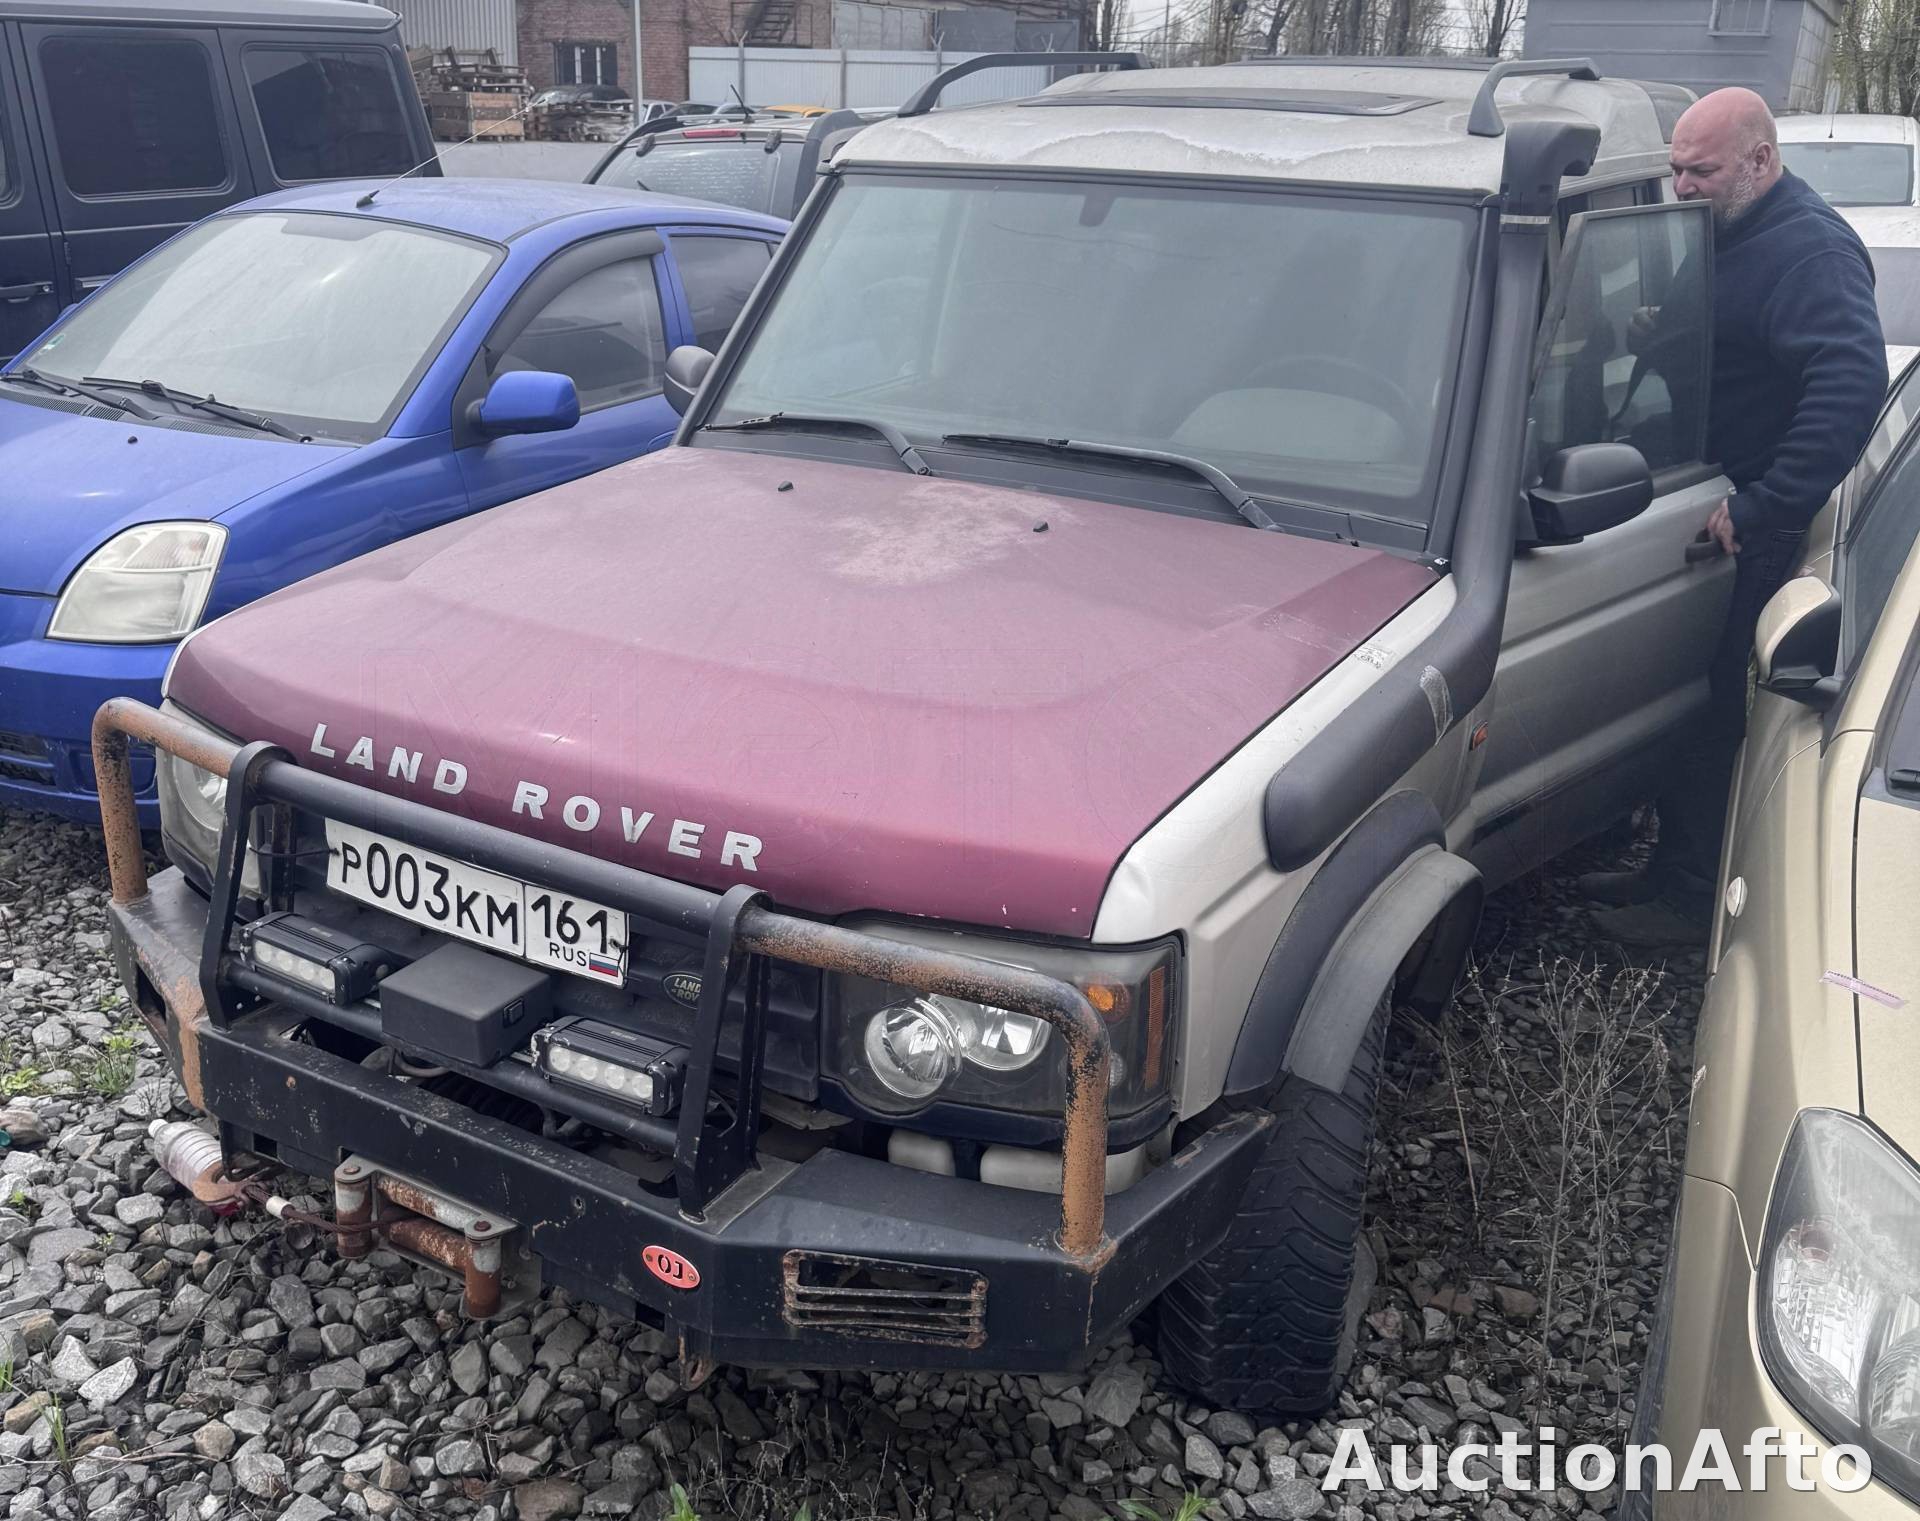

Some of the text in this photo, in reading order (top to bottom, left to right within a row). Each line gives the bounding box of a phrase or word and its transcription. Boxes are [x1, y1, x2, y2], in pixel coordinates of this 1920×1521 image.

[310, 723, 763, 871] LAND ROVER
[531, 894, 609, 954] 161
[549, 942, 587, 967] RUS
